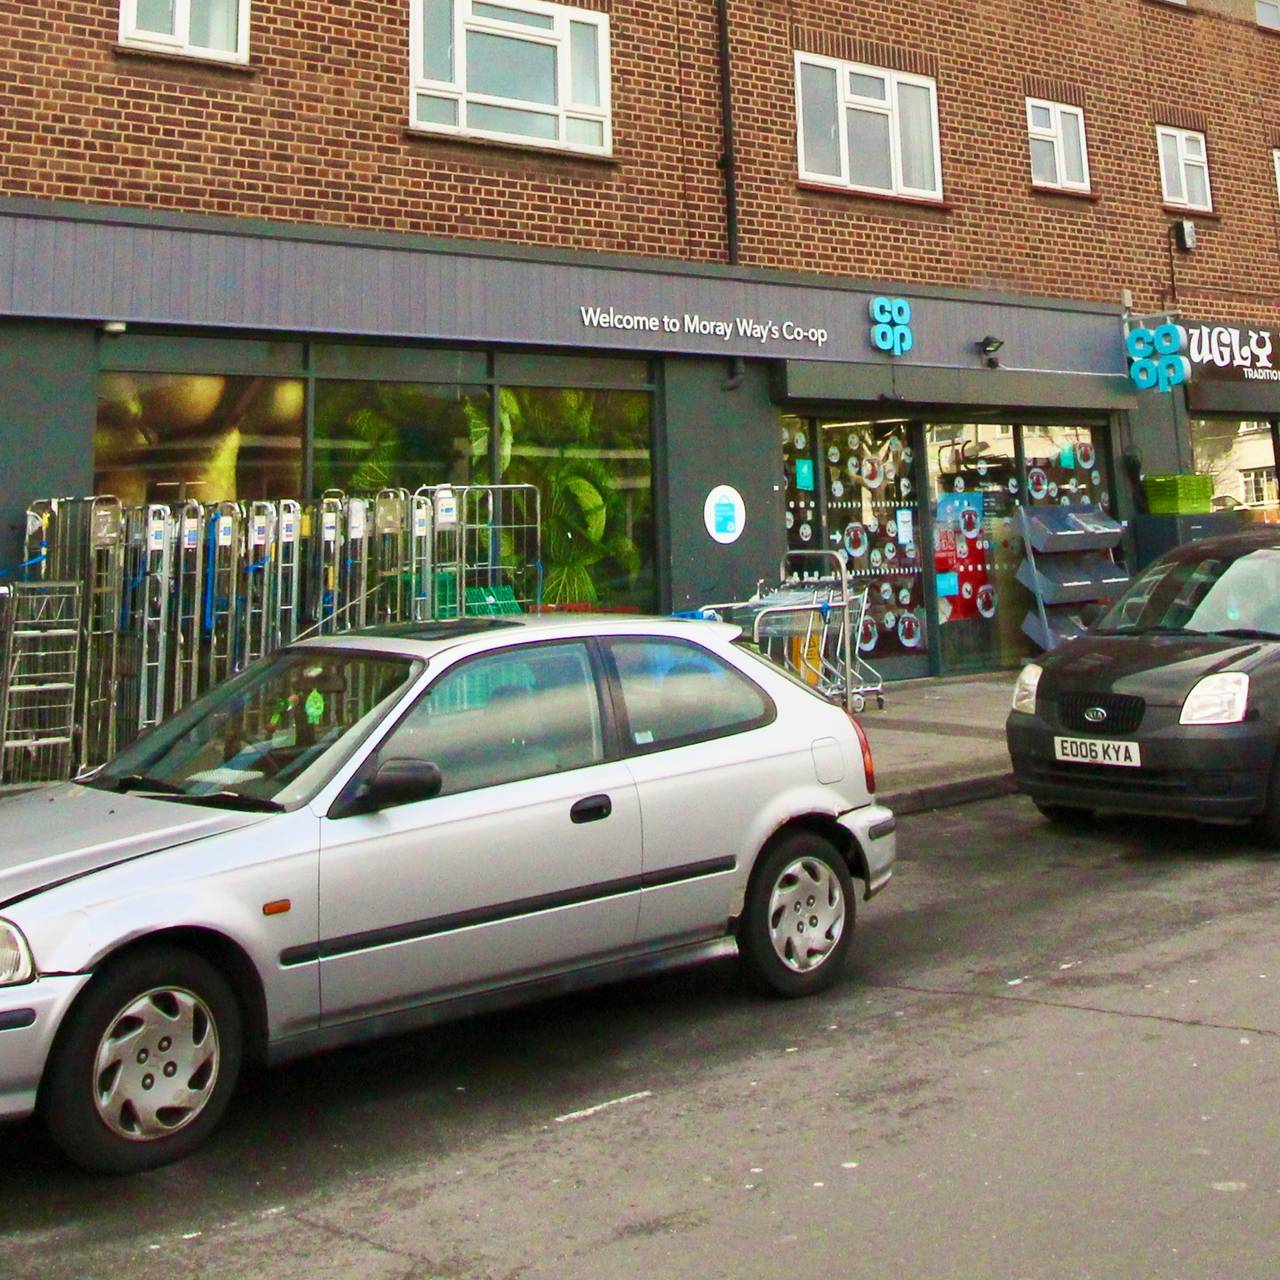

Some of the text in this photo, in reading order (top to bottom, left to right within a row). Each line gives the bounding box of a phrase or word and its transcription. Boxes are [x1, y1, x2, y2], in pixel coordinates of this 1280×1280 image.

[580, 306, 828, 346] Welcome to Moray Way's Co-op
[1189, 325, 1273, 369] UGLY
[1102, 743, 1133, 762] KYA
